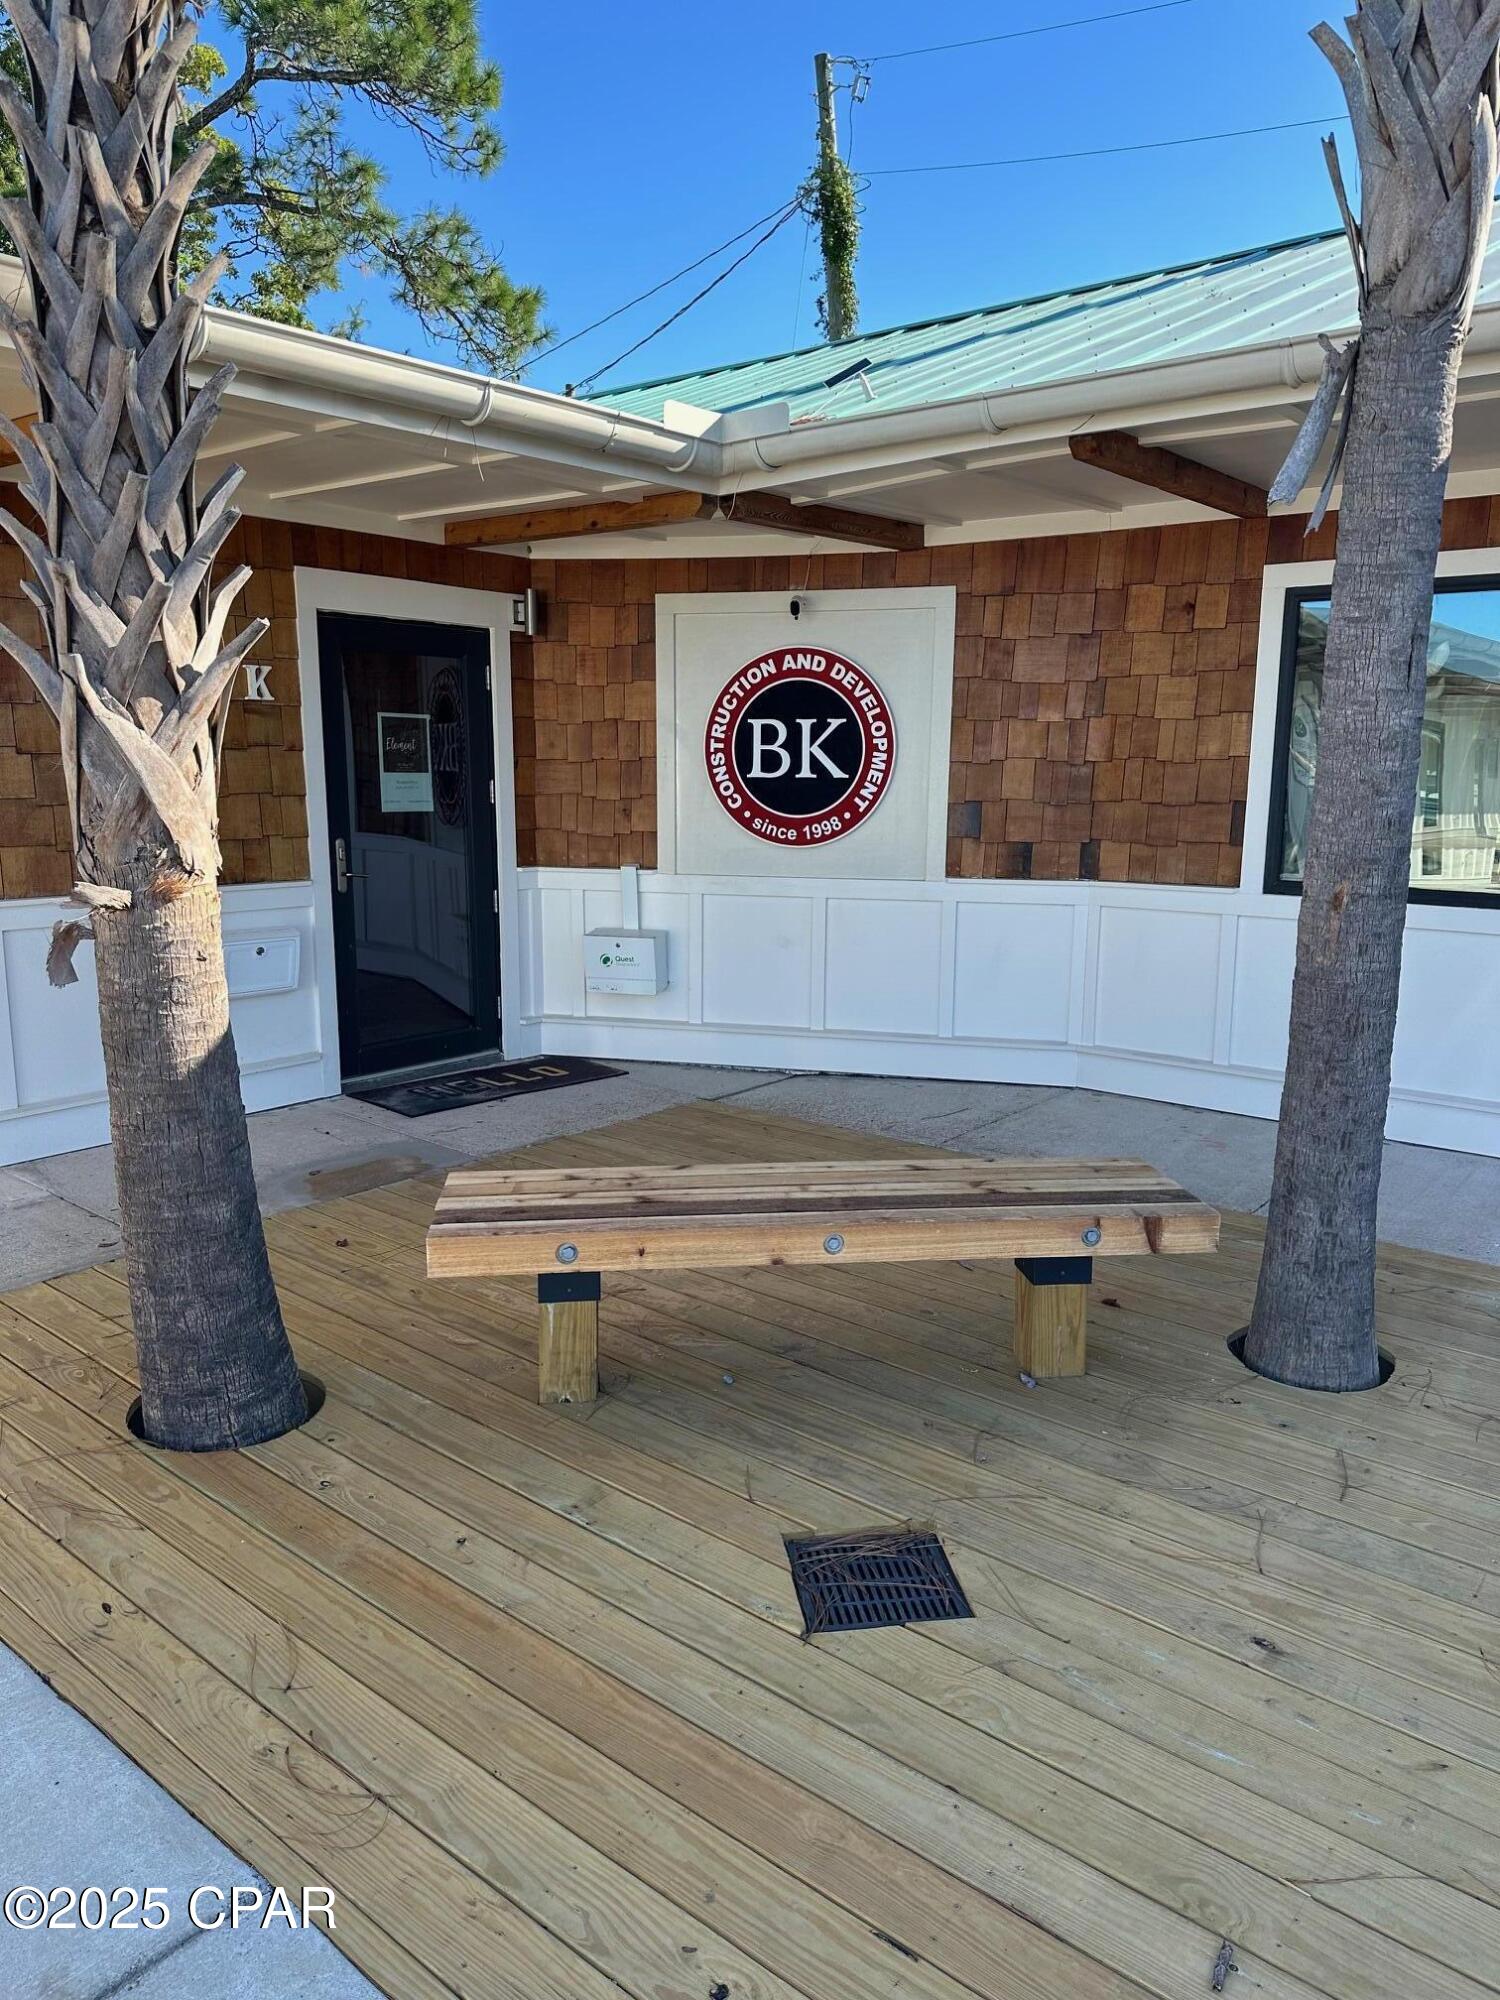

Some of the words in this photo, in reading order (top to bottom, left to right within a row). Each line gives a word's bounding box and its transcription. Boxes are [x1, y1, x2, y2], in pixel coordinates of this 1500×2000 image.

[243, 664, 274, 700] K
[710, 658, 777, 809] CONSTRUCTION
[782, 654, 826, 672] AND
[829, 662, 888, 812] DEVELOPMENT
[747, 718, 849, 778] BK
[752, 817, 797, 840] since
[803, 816, 842, 839] 1998
[615, 955, 634, 963] Quest
[407, 1066, 570, 1099] HELLO
